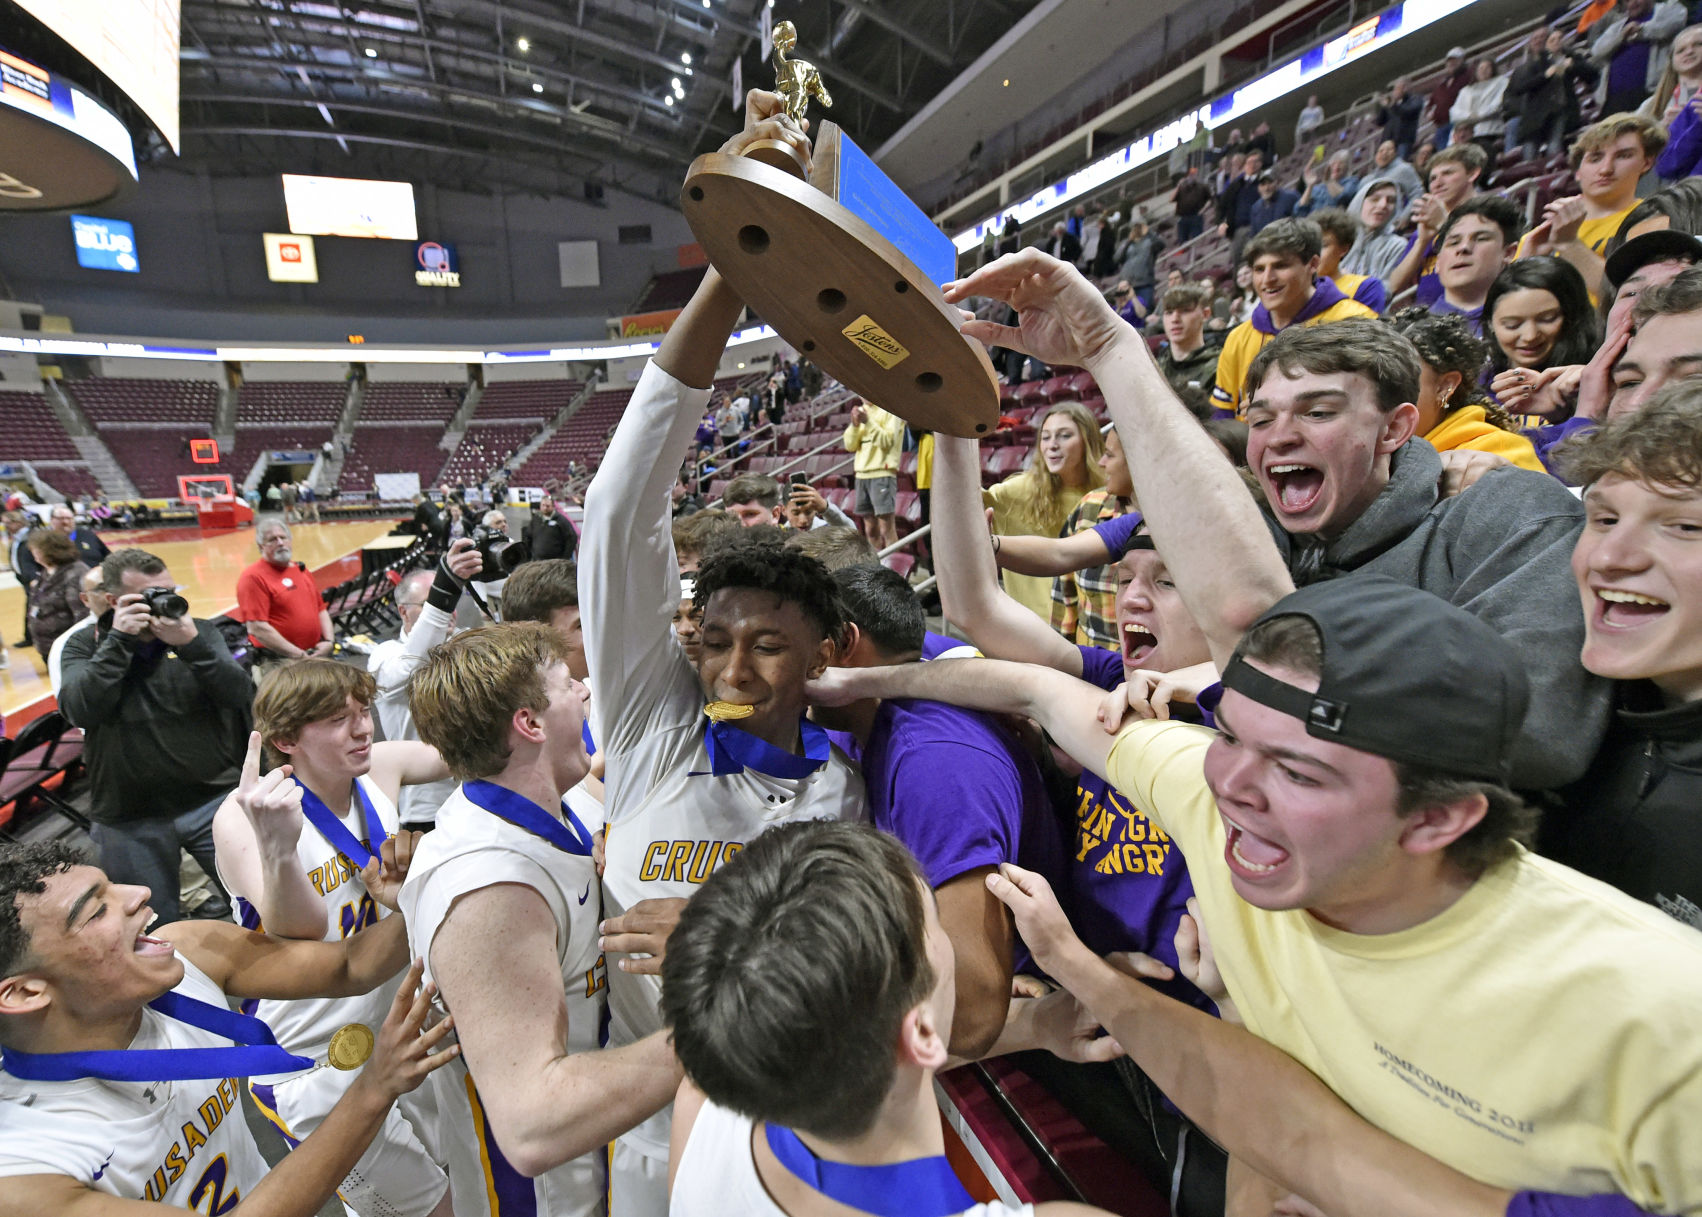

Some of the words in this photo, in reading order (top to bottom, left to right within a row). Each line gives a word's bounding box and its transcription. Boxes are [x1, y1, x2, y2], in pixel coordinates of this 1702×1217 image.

[845, 325, 900, 352] Jostens
[1374, 1041, 1482, 1112] HOMECOMING
[187, 1150, 240, 1217] 2
